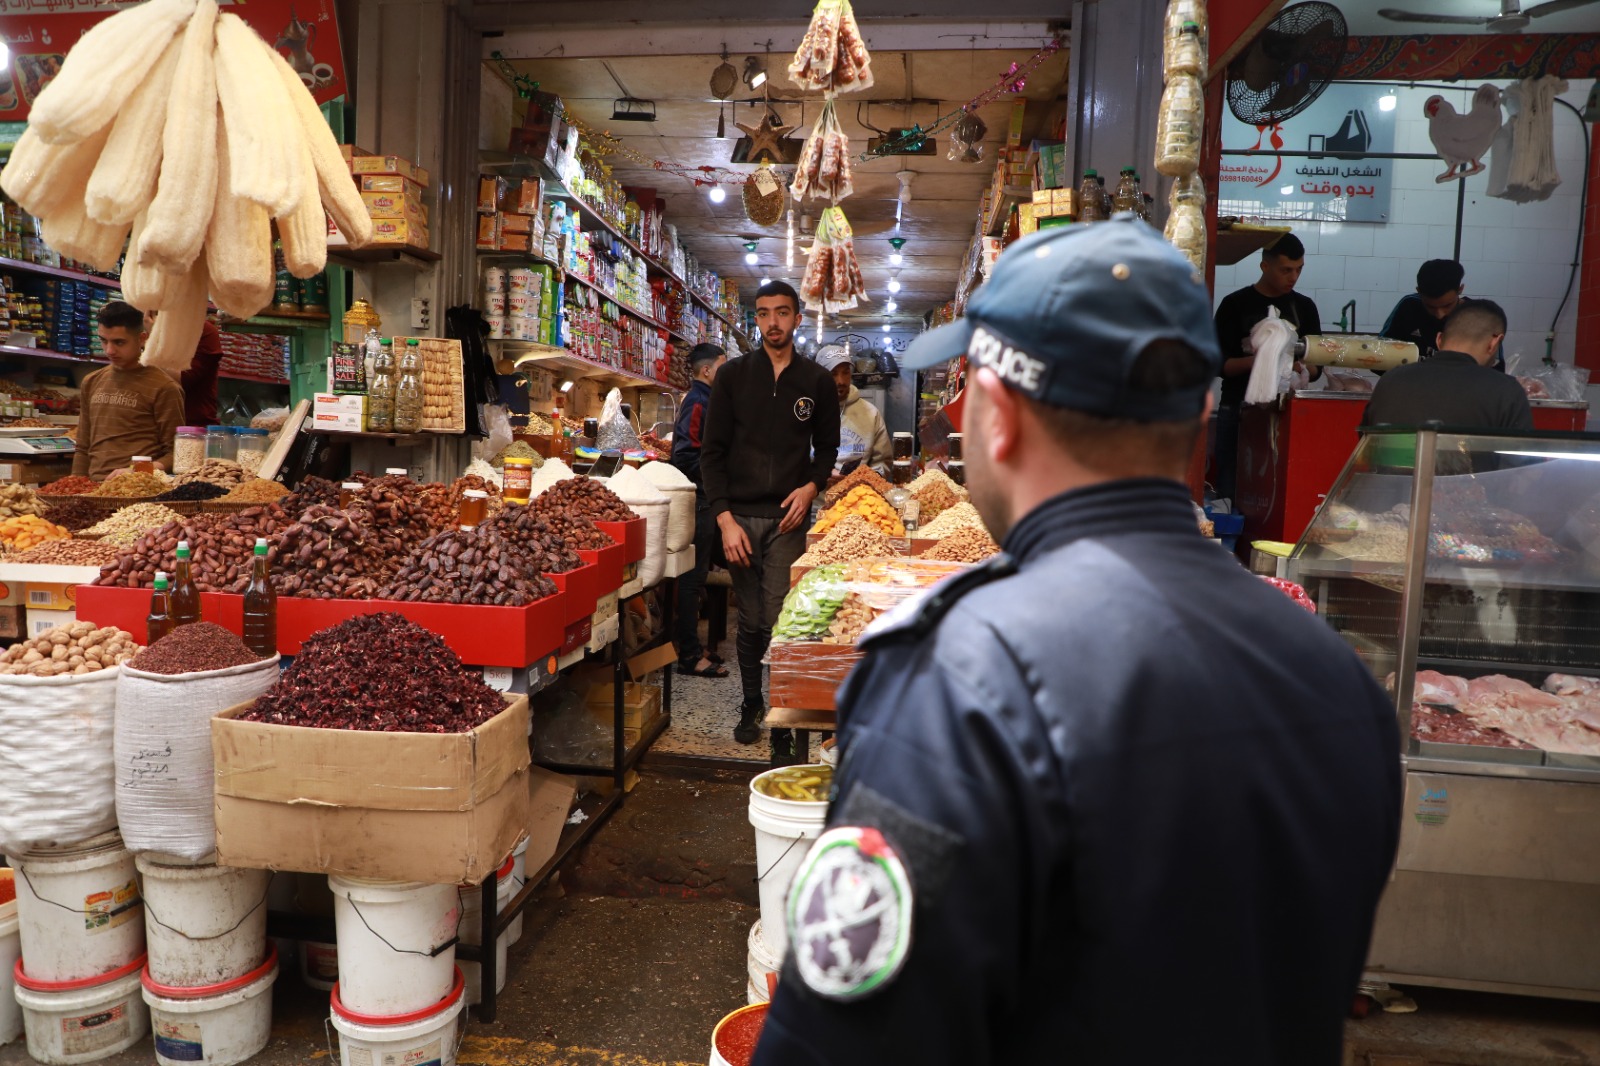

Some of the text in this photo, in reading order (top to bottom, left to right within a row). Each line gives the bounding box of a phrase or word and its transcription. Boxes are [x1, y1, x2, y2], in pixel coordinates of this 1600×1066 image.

[1296, 165, 1382, 178] الشغل النظيف
[1301, 181, 1375, 198] بدو وقت
[968, 327, 1046, 391] POLICE
[489, 669, 506, 679] 5KG
